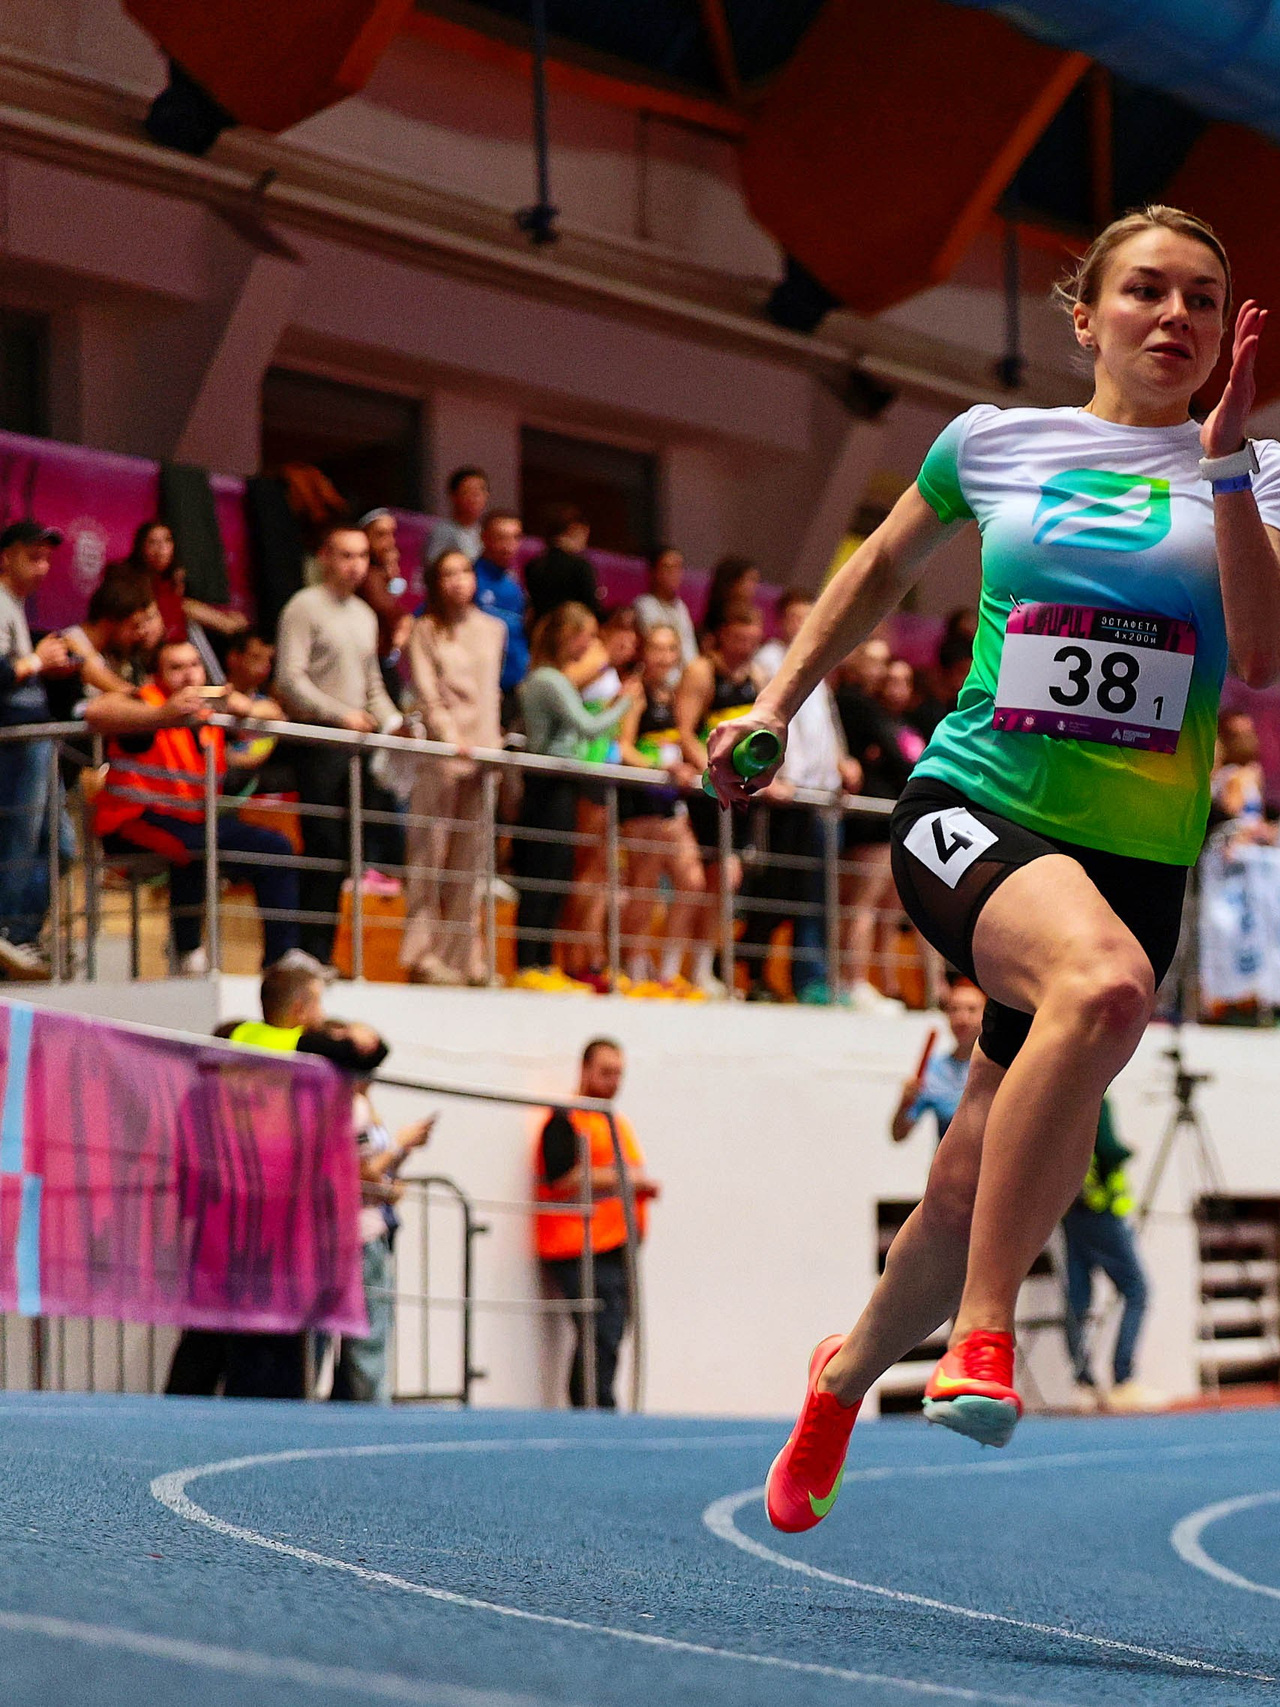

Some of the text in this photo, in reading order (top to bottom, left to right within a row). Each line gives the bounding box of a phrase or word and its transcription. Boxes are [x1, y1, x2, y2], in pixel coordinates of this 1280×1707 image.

[1101, 616, 1157, 632] ЭСТАФЕТА
[1049, 646, 1139, 714] 38
[1153, 696, 1164, 720] 1
[931, 816, 974, 865] 4
